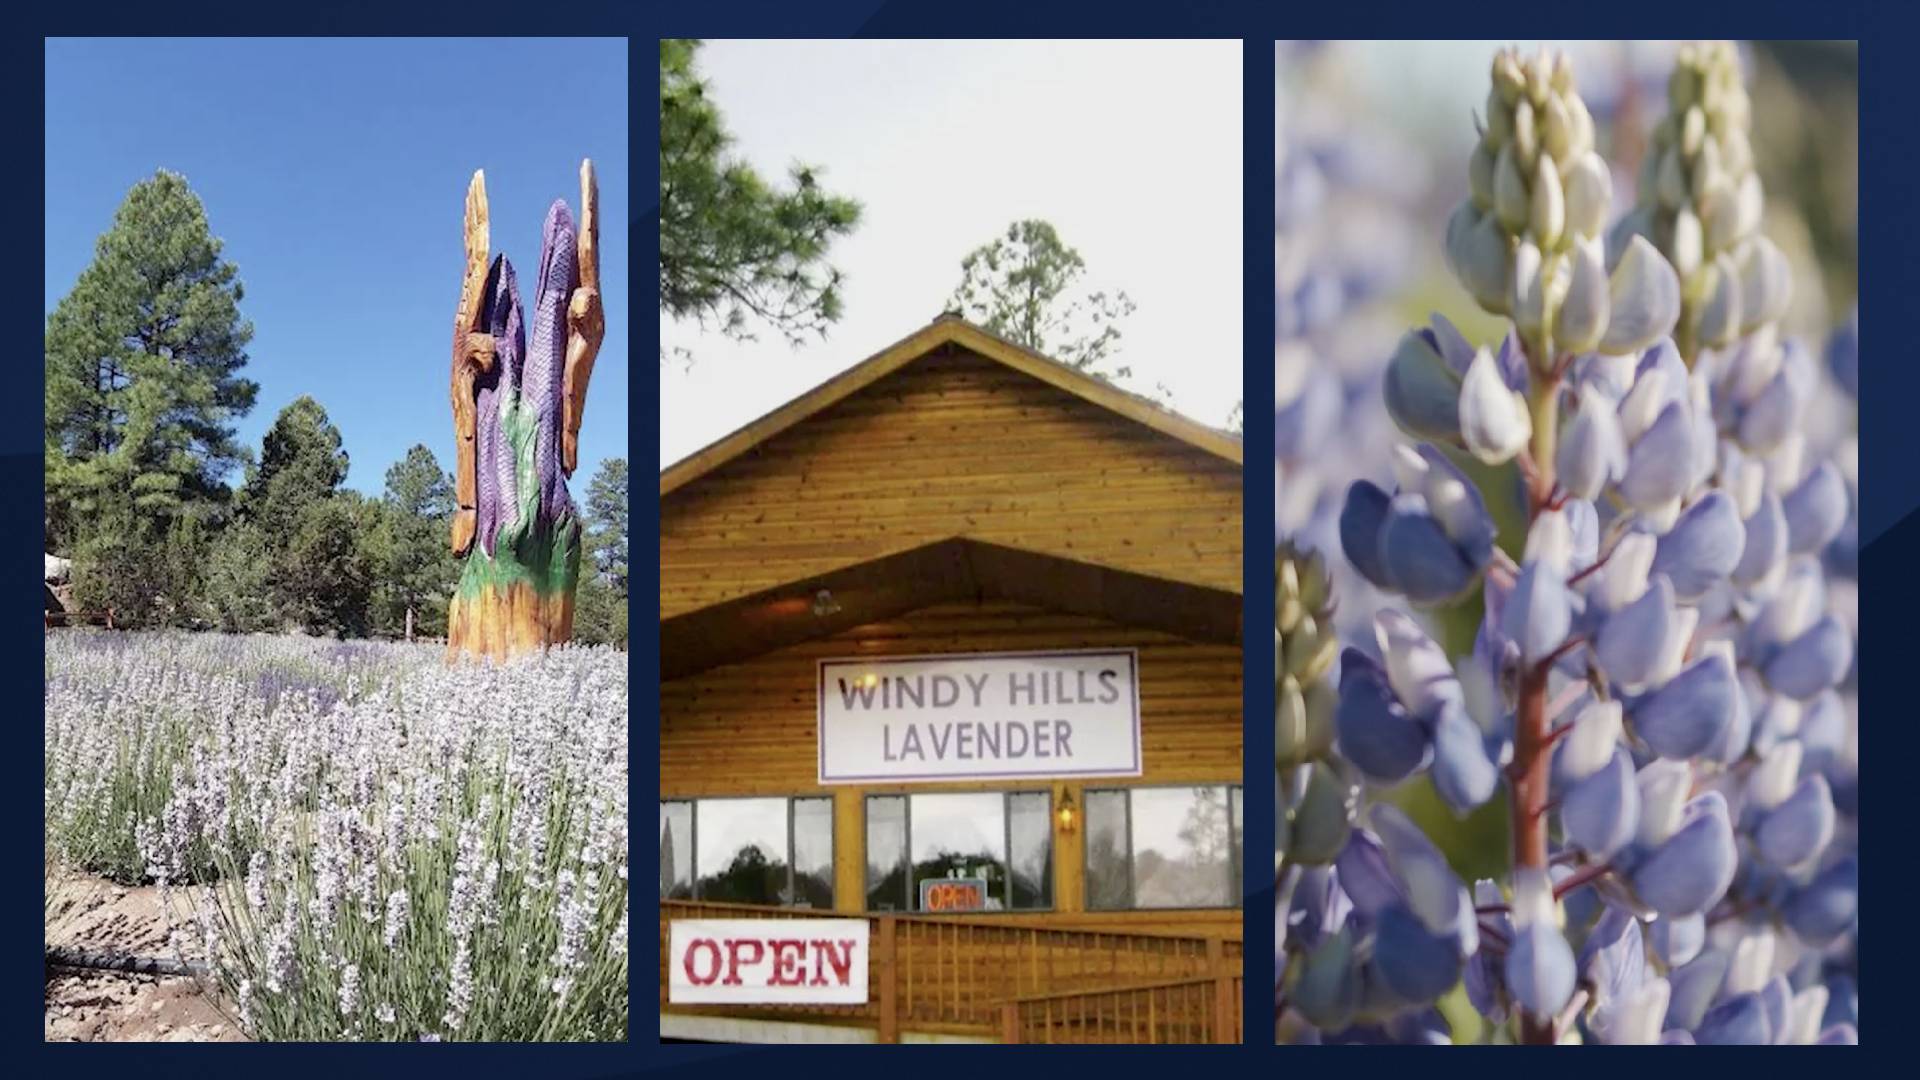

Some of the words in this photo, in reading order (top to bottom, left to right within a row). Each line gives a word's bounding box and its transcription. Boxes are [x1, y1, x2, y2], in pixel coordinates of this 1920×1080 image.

[838, 673, 989, 711] WINDY
[1008, 669, 1120, 706] HILLS
[883, 720, 1073, 762] LAVENDER
[928, 884, 981, 912] OPEN
[683, 937, 856, 987] OPEN
